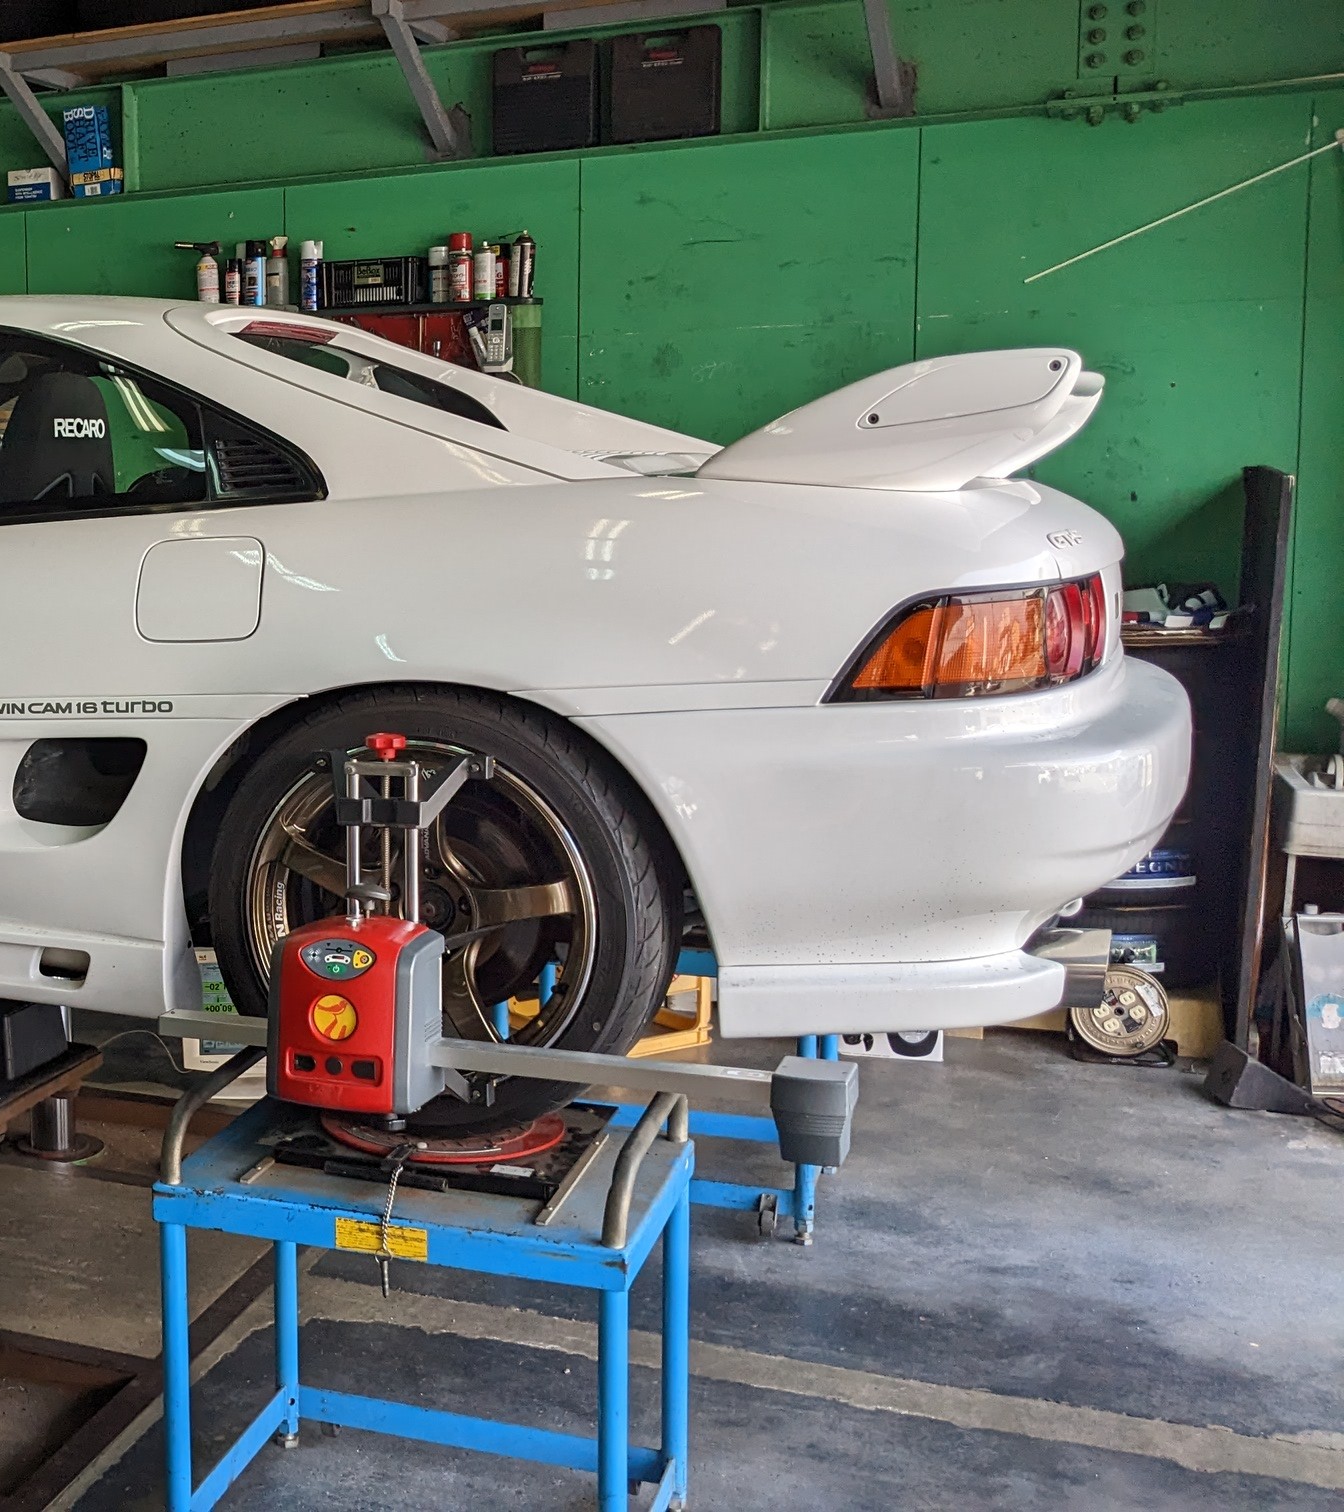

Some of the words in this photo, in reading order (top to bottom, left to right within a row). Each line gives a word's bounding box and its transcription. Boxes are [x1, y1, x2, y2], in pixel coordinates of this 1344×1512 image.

[54, 417, 105, 438] RECARO
[28, 702, 72, 714] CAM
[76, 702, 97, 714] 16
[101, 700, 173, 714] turbo
[275, 881, 285, 921] Racing
